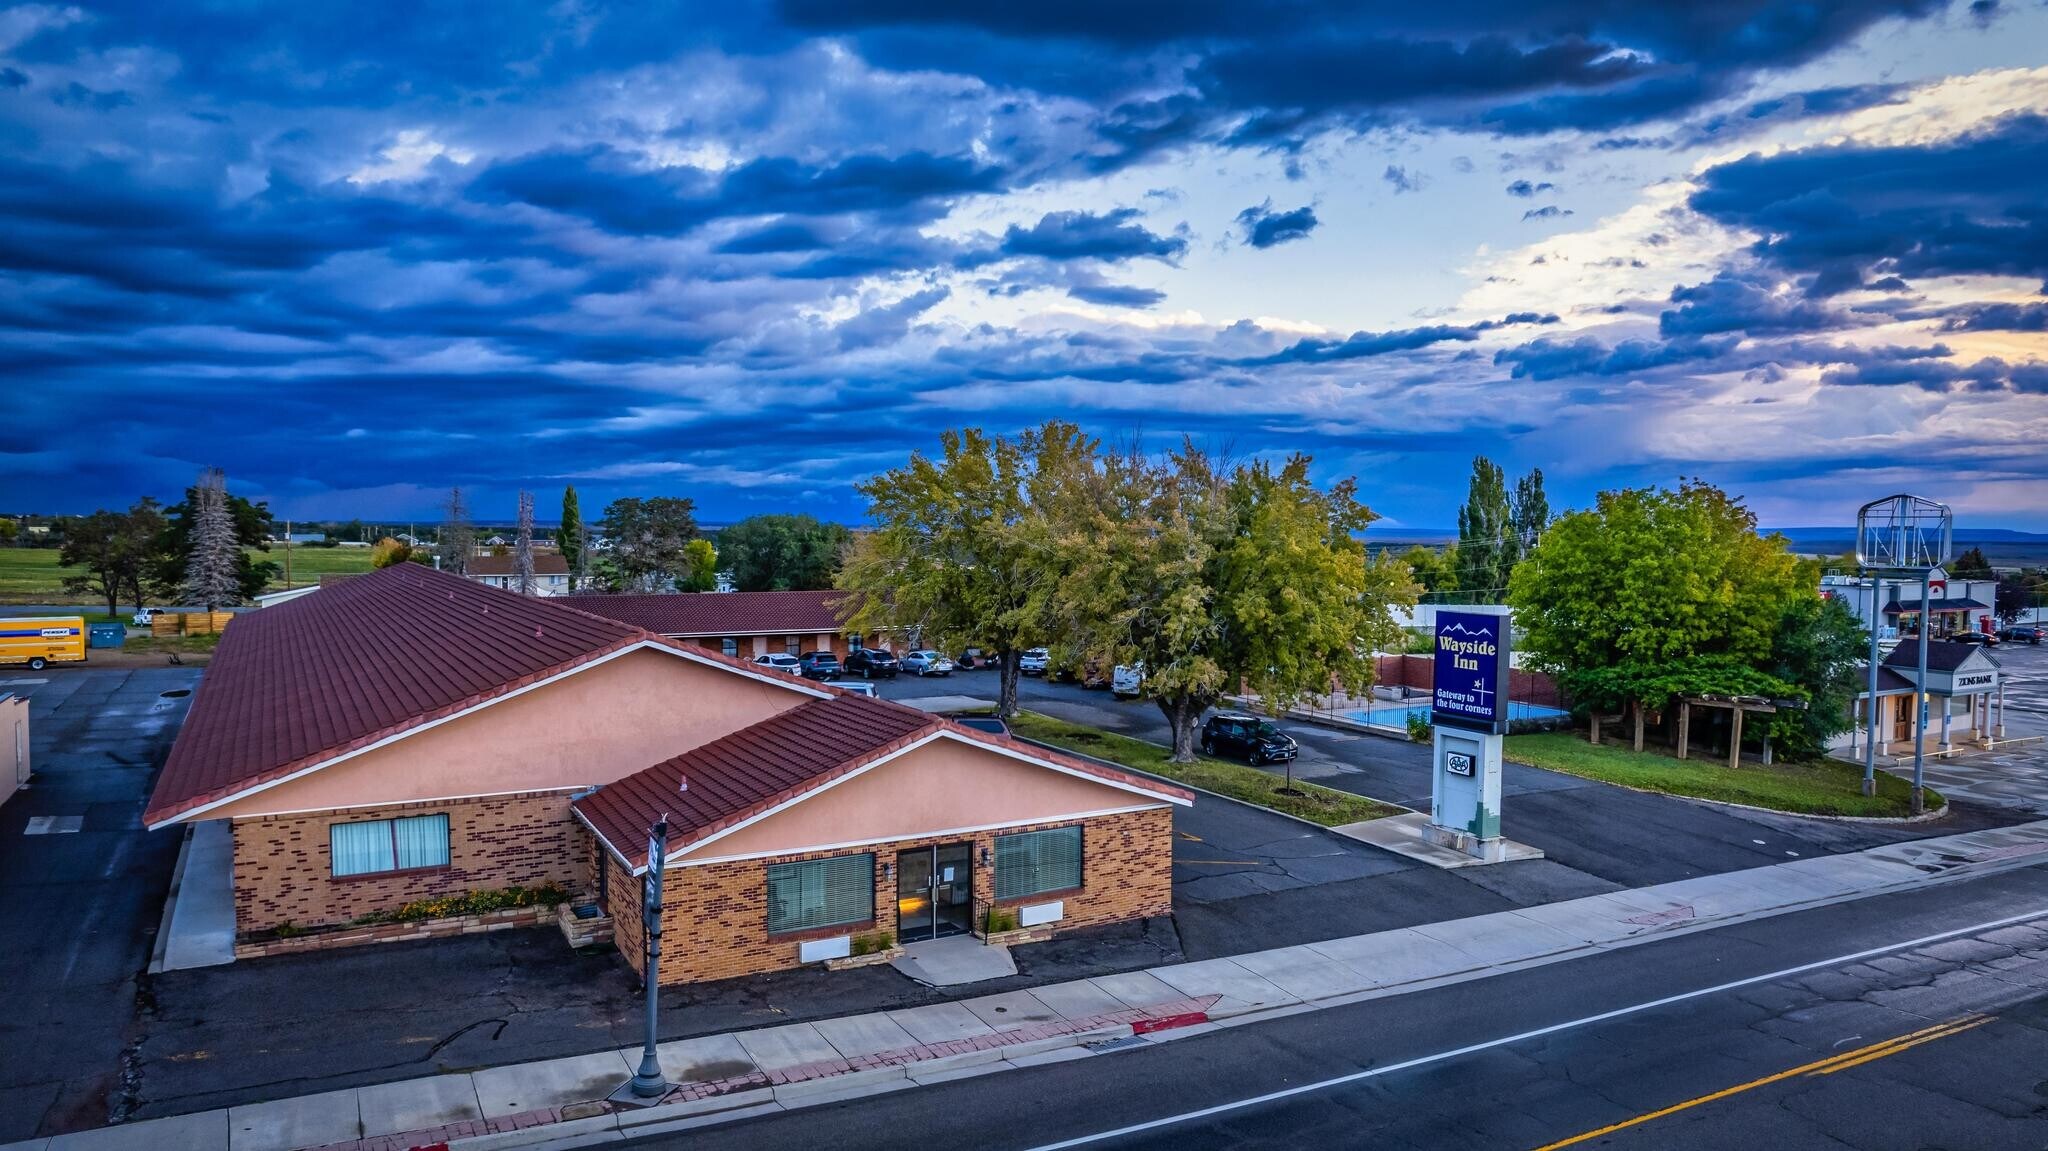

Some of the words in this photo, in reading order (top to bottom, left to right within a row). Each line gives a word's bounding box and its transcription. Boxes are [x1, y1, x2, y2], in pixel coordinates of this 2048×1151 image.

[1439, 636, 1496, 655] Wayside
[1453, 654, 1478, 670] Inn
[1976, 675, 1992, 684] BANK
[1437, 688, 1466, 702] Gateway
[1467, 694, 1475, 702] to
[1437, 699, 1448, 708] the
[1448, 700, 1464, 710] four
[1465, 704, 1492, 715] corners
